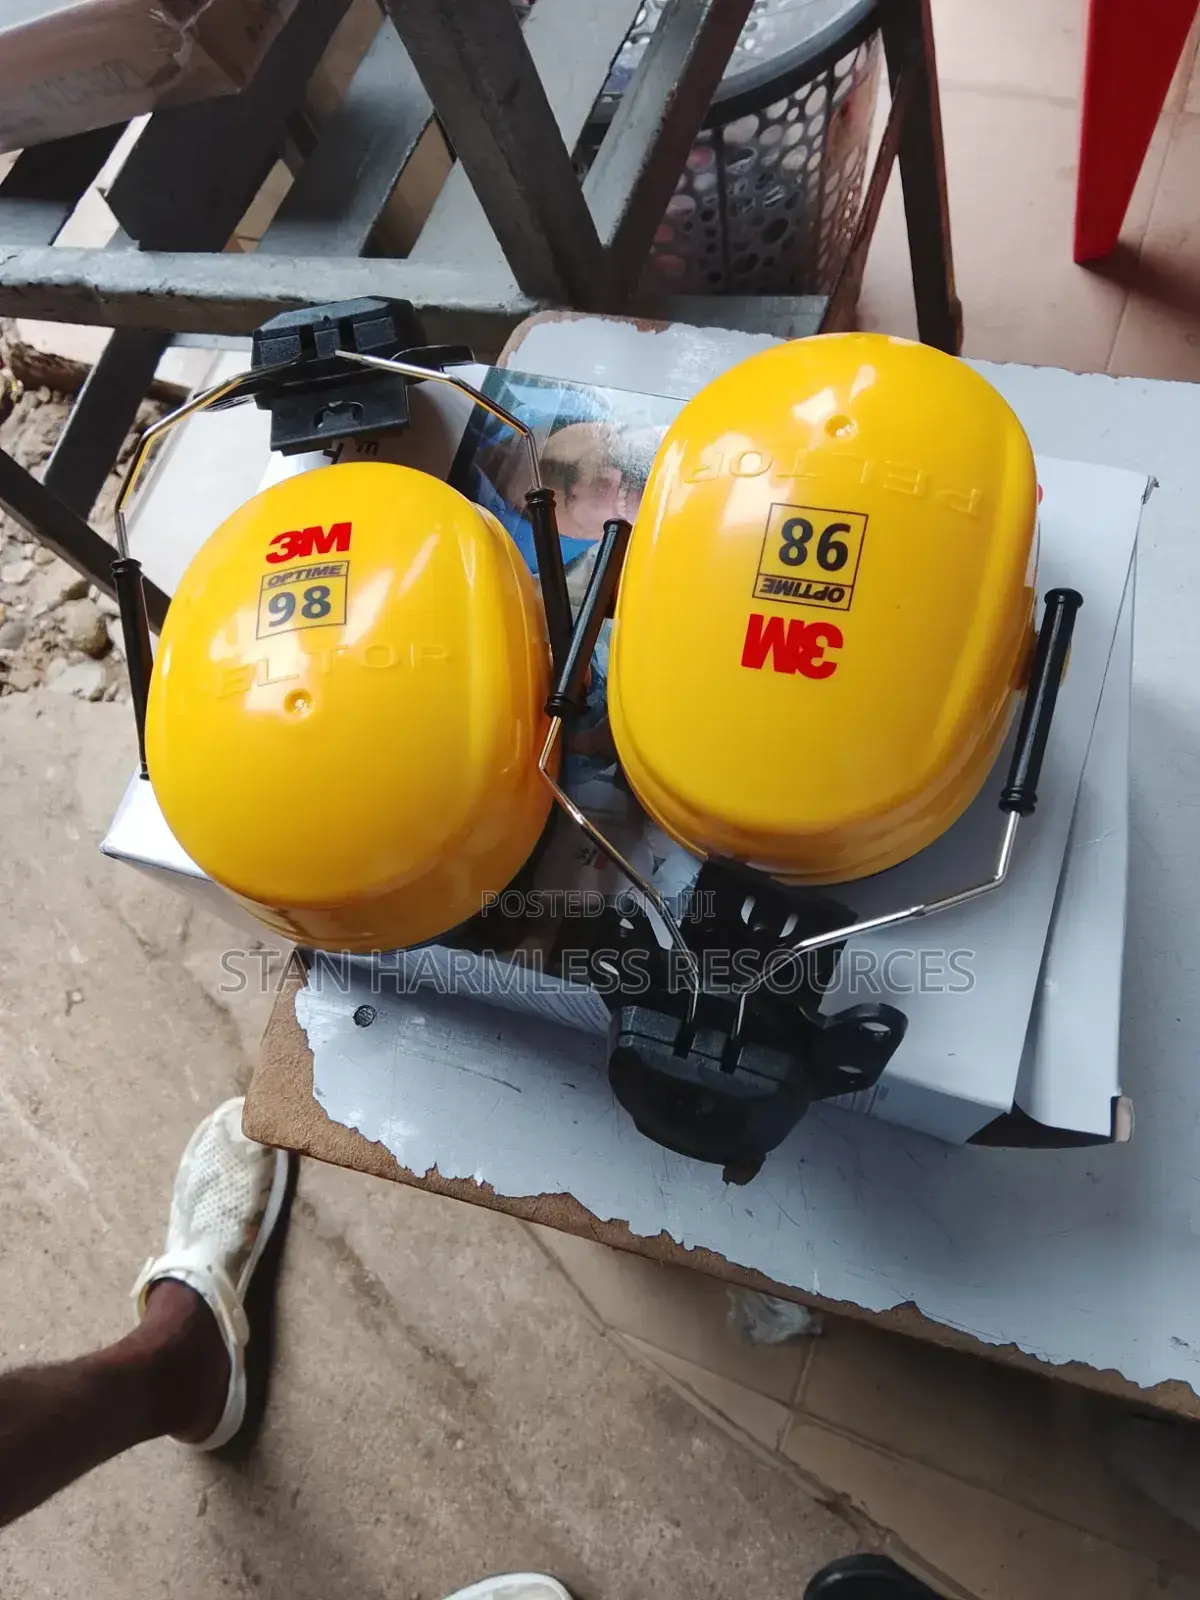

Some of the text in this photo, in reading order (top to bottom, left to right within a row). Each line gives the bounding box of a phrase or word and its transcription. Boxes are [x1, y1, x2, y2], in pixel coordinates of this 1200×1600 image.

[265, 521, 353, 564] 3M
[777, 517, 852, 572] 98
[267, 564, 345, 587] OPTIME
[759, 577, 846, 603] OPTIME
[268, 585, 331, 628] 98
[740, 613, 844, 679] 3M
